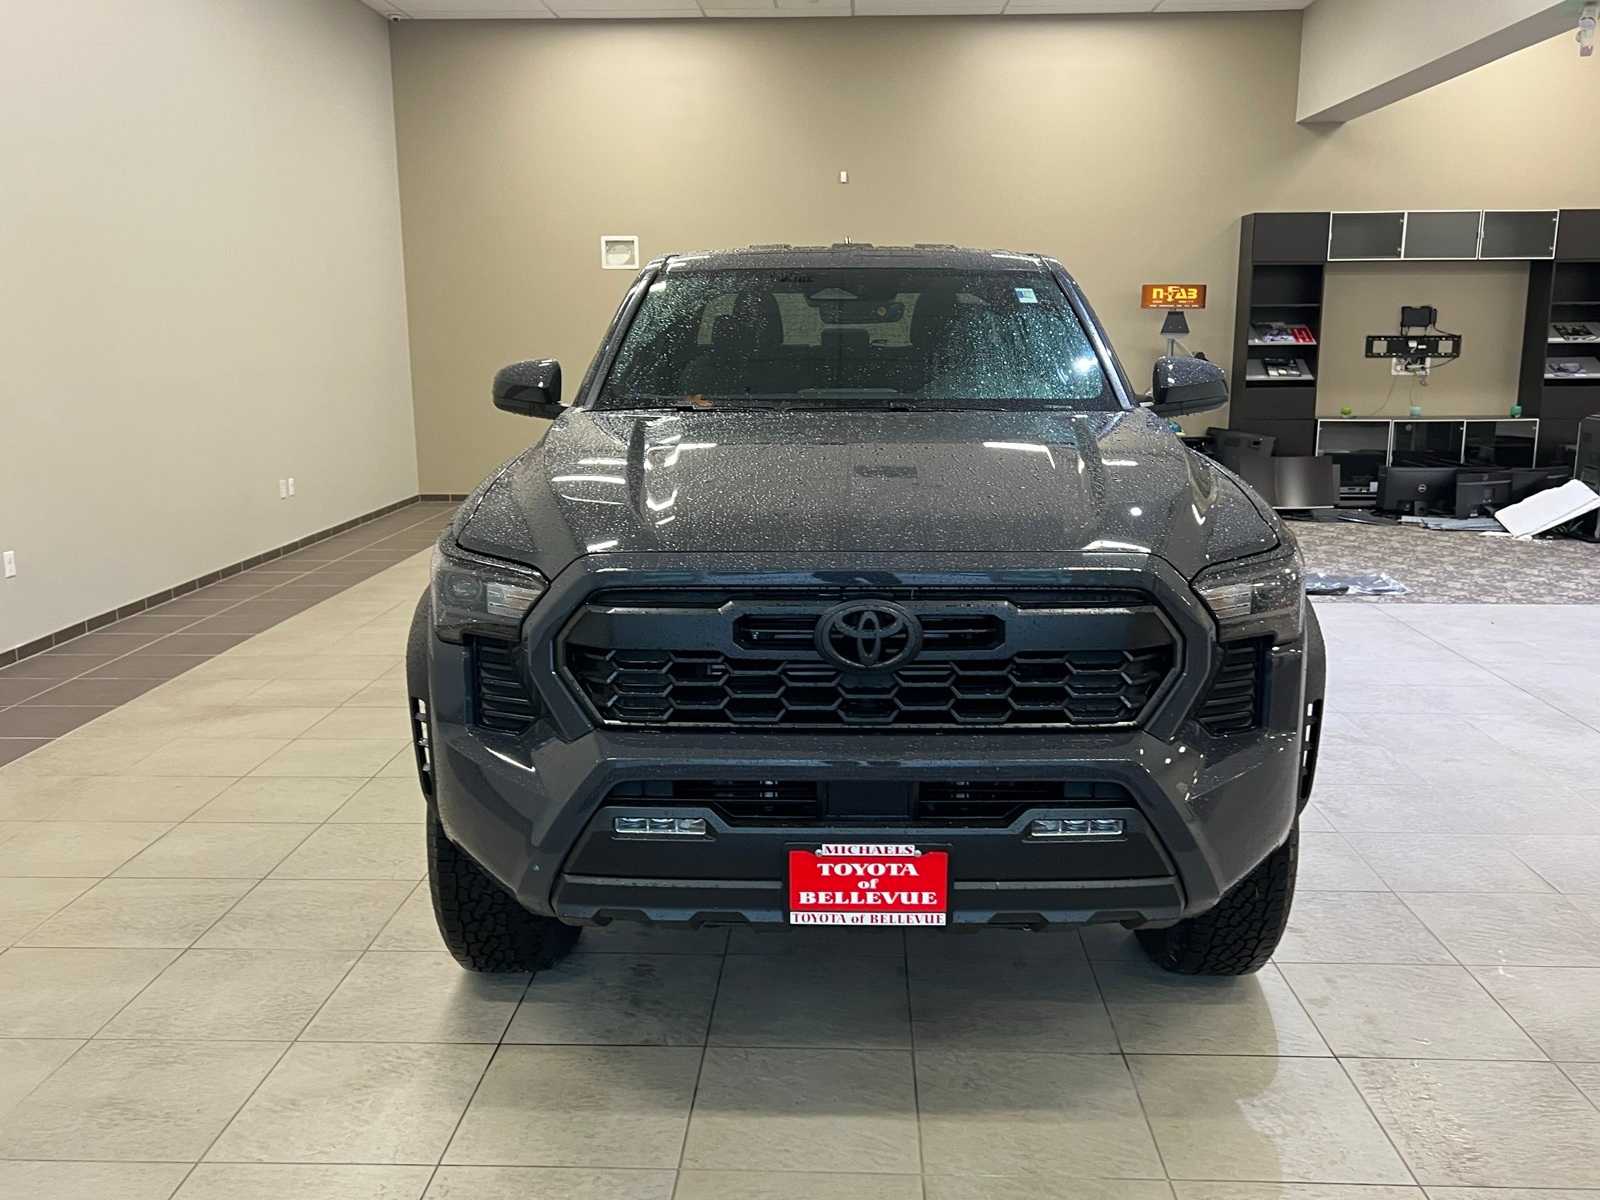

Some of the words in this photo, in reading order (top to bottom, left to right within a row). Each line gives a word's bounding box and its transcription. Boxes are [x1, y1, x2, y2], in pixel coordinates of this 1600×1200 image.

[823, 845, 914, 855] MICHAELS
[816, 863, 920, 877] TOYOTA
[857, 878, 880, 889] of
[798, 891, 937, 905] BELLEVUE
[792, 913, 847, 924] TOYOTA
[851, 913, 866, 924] of
[870, 914, 945, 925] BELLEVUE
